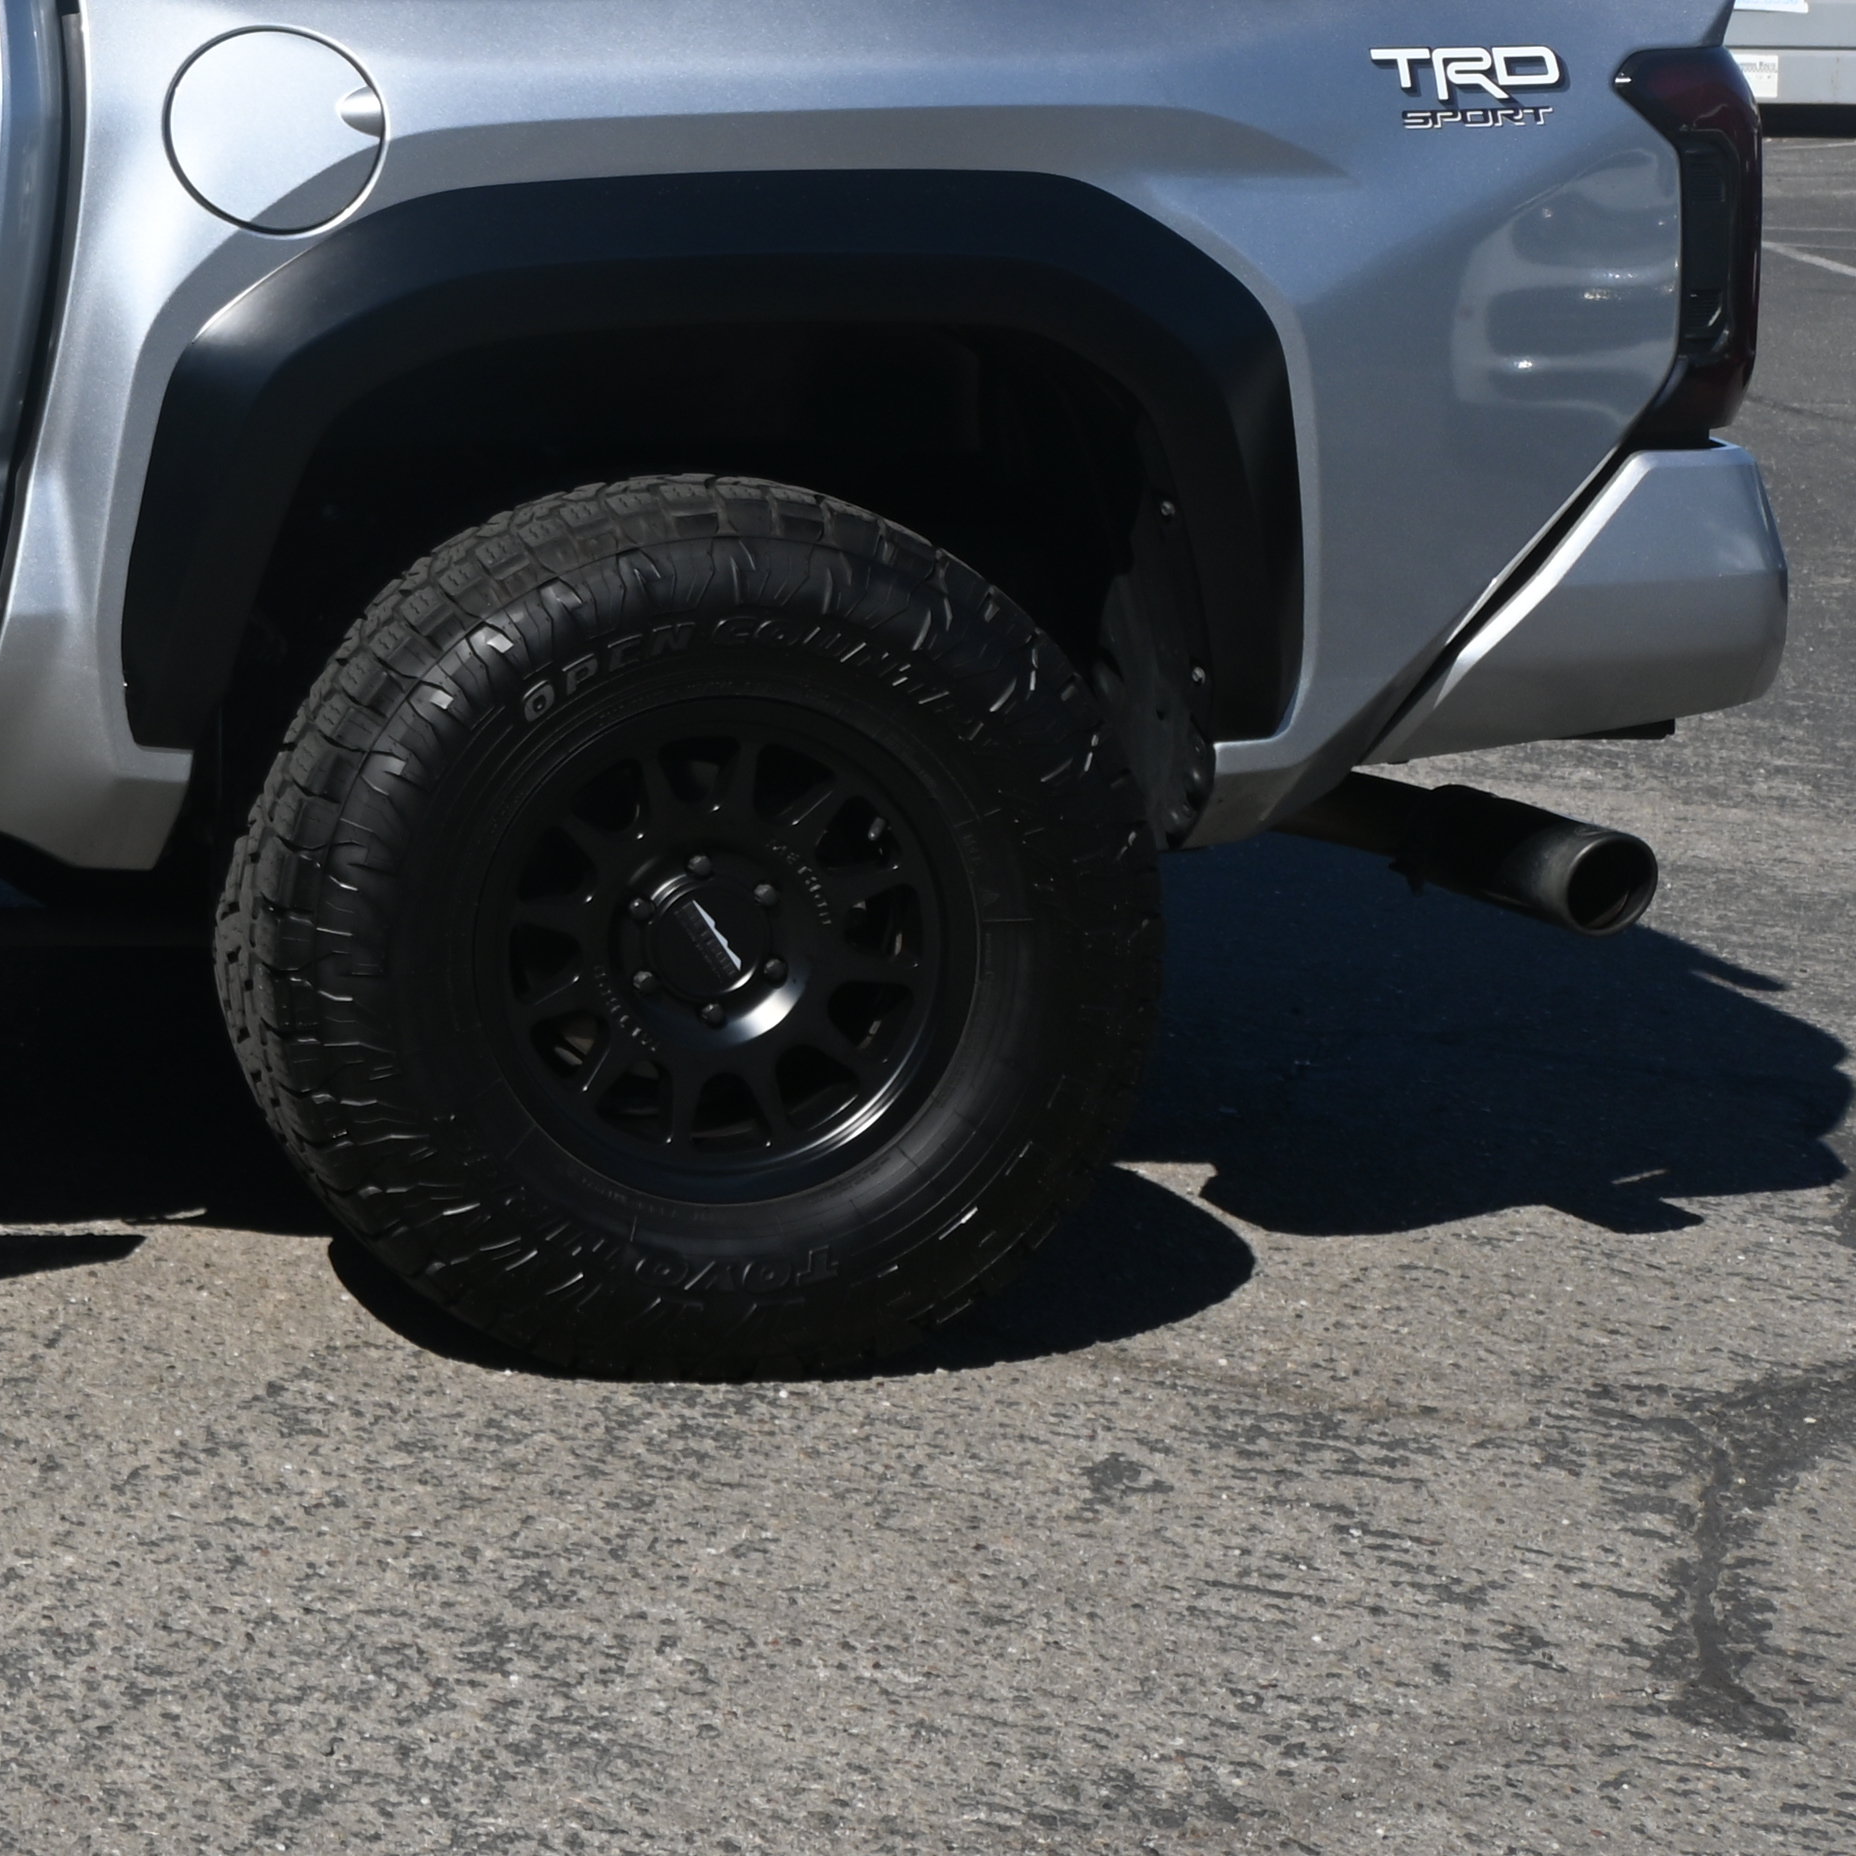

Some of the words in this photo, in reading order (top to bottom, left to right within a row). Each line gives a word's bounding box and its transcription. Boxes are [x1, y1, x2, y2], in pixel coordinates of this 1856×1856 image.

[1370, 46, 1561, 101] TRD
[1401, 106, 1554, 129] SPORT
[521, 621, 697, 723] OPEN
